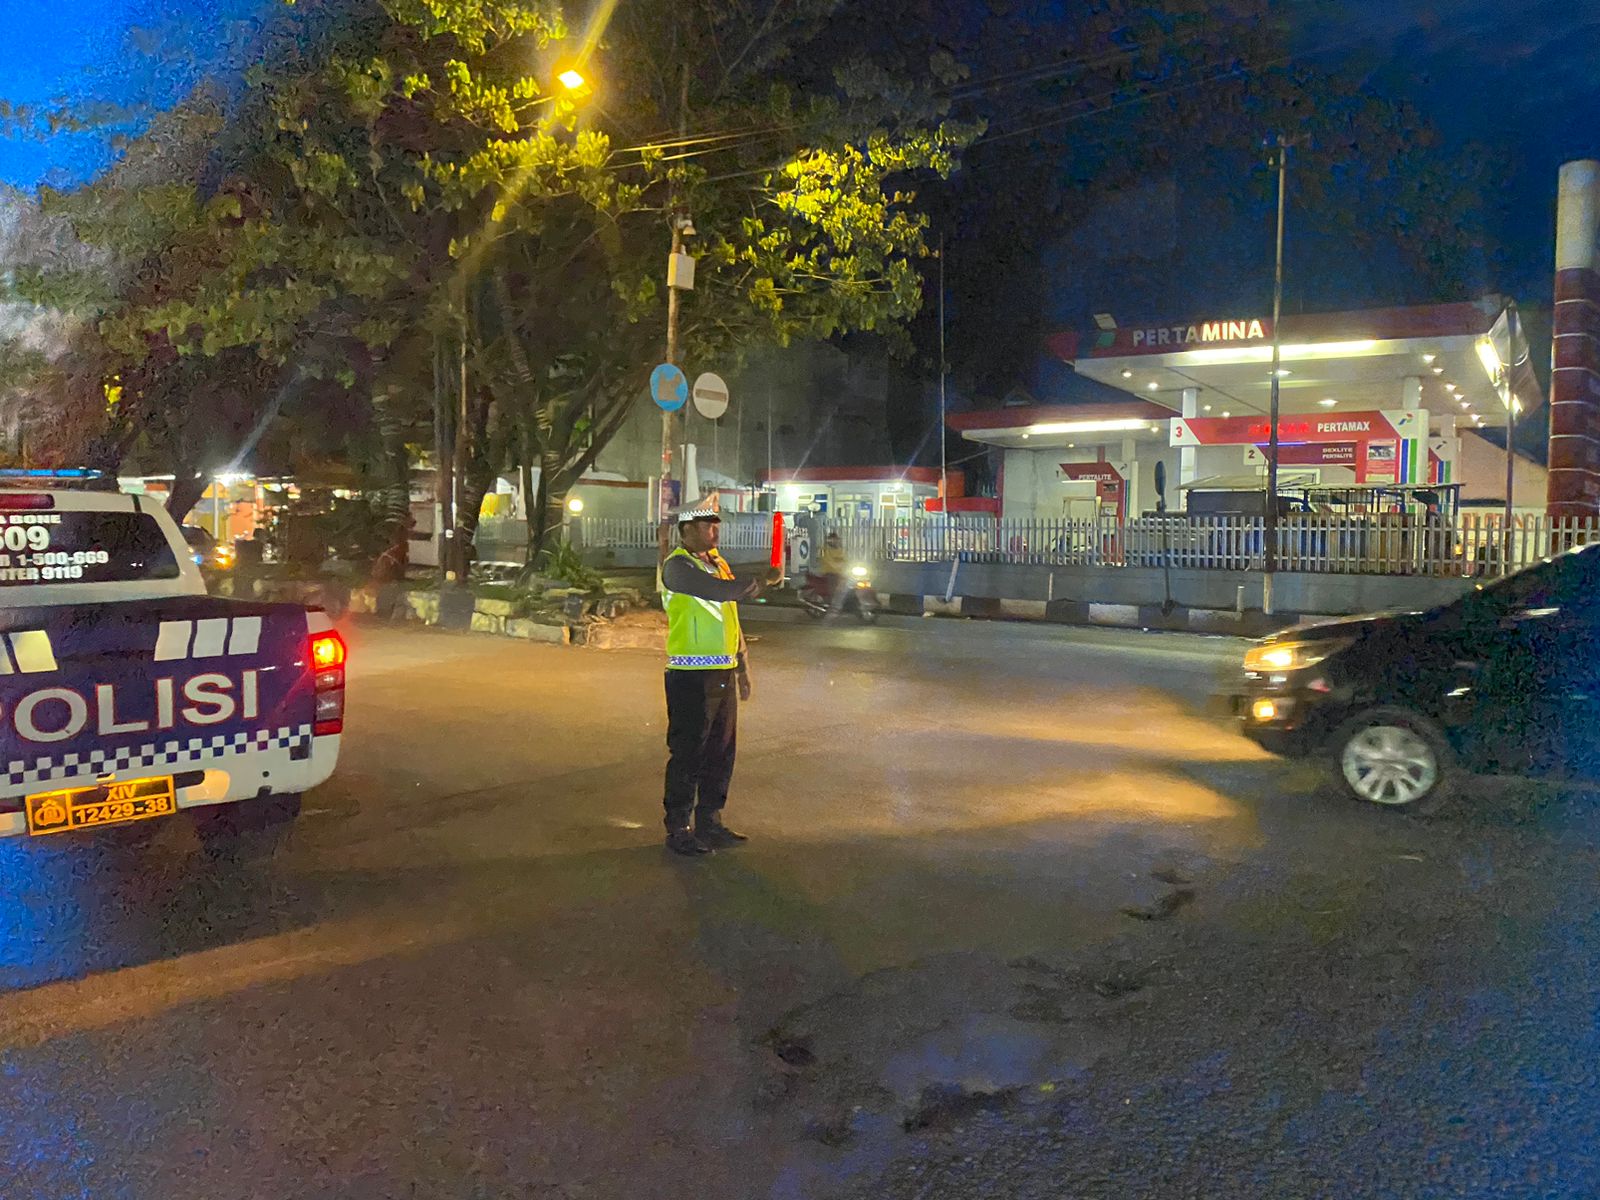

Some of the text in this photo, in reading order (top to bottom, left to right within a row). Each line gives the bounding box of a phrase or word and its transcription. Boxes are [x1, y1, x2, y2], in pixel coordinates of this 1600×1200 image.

[1133, 319, 1264, 347] PERTAMINA
[1175, 426, 1183, 438] 3
[1317, 421, 1370, 433] PERTAMAX
[1248, 449, 1256, 459] 2
[9, 514, 62, 525] BONE
[0, 525, 50, 552] 09
[16, 551, 109, 567] 1-500-669
[41, 564, 83, 579] 9119
[0, 670, 260, 743] OLISI
[106, 784, 137, 801] XIV
[76, 797, 169, 823] 12429-38
